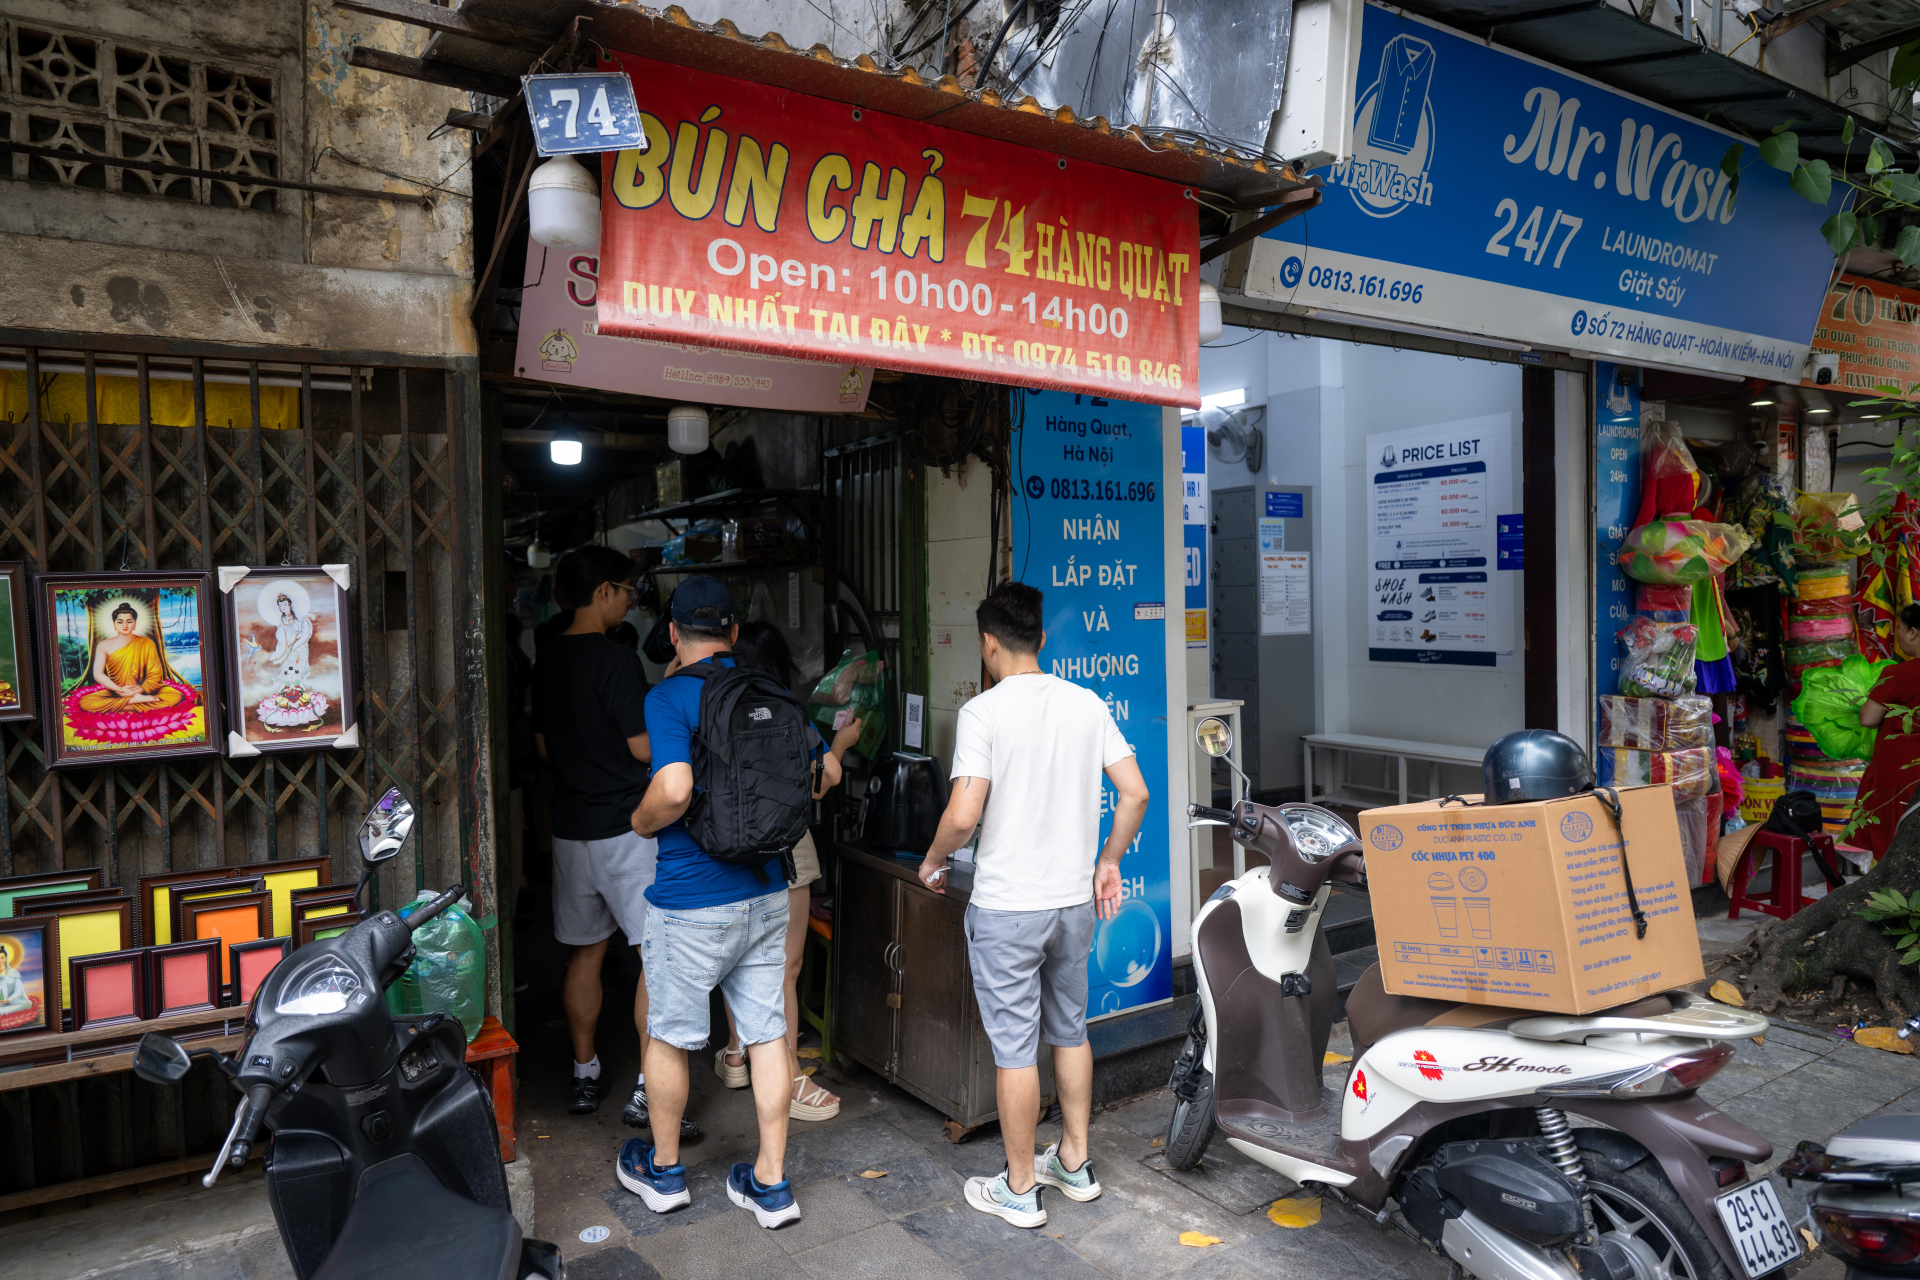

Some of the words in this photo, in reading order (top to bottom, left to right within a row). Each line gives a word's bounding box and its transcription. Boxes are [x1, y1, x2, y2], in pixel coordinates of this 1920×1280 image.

[550, 87, 619, 137] 74
[1614, 118, 1737, 225] Wash
[611, 104, 791, 234] BÚN
[806, 147, 946, 263] CHẢ
[960, 188, 1034, 277] 74
[1035, 214, 1111, 292] HÀNG
[1118, 242, 1190, 314] QUẠT
[1486, 197, 1583, 270] 24/7
[1601, 225, 1719, 277] LAUNDROMAT
[706, 236, 851, 297] Open:
[1307, 264, 1424, 305] 0813.161.696
[1618, 267, 1653, 300] Giặt
[1656, 273, 1686, 308] Sấy
[1830, 280, 1876, 326] 70
[623, 279, 697, 322] DUY
[707, 291, 800, 337] NHẤT
[809, 308, 861, 348] TẠI
[868, 314, 930, 354] ĐÂY
[961, 332, 1007, 365] ĐT:
[1013, 338, 1078, 375] 0974
[1086, 350, 1133, 382] 519
[1139, 359, 1183, 391] 846
[1588, 311, 1611, 337] SỐ
[1609, 321, 1625, 340] 72
[1626, 321, 1662, 346] HÀNG
[1776, 350, 1796, 373] NỘI
[1830, 330, 1857, 347] QUẠT
[1840, 351, 1865, 366] PHỤC
[664, 367, 703, 383] Hotline:
[755, 378, 771, 390] 993
[1046, 415, 1086, 438] Hàng
[1091, 418, 1132, 441] Quạt,
[1598, 423, 1640, 440] LAUNDROMAT
[1063, 444, 1085, 462] Hà
[1089, 447, 1114, 468] Nội
[1402, 444, 1445, 464] PRICE
[1449, 439, 1481, 458] LIST
[1610, 447, 1628, 461] OPEN
[1610, 470, 1628, 483] 24Hrs
[1050, 477, 1156, 503] 0813.161.696
[1063, 513, 1120, 545] NHẬN
[1052, 555, 1092, 587] LẮP
[1098, 558, 1138, 591] ĐẶT
[1377, 561, 1392, 570] FREE
[1375, 578, 1407, 592] SHOE
[1612, 574, 1626, 592] MỞ
[1380, 591, 1413, 606] WASH
[1609, 600, 1628, 618] CỬA
[1083, 605, 1110, 632] VÀ
[1052, 652, 1140, 682] NHƯỢNG
[1417, 823, 1438, 832] CÔNG
[1450, 823, 1472, 831] TNHH
[1473, 821, 1497, 831] NHỰA
[1498, 819, 1516, 829] ĐỨC
[1517, 819, 1537, 828] ANH
[1564, 822, 1590, 831] PLASTIC
[1580, 830, 1586, 838] A
[1434, 836, 1448, 844] DUC
[1450, 835, 1465, 843] ANH
[1465, 834, 1492, 843] PLASTIC
[1510, 833, 1523, 842] LTD
[1411, 849, 1430, 862] CỐC
[1431, 851, 1458, 863] NHỰA
[1459, 851, 1475, 861] PET
[1477, 851, 1496, 861] 400
[1564, 850, 1574, 858] Tên
[1574, 848, 1587, 857] hàng
[1597, 843, 1607, 852] Cốc
[1608, 842, 1620, 850] nhựa
[1620, 840, 1630, 848] PET
[1599, 856, 1609, 864] PET
[1598, 869, 1610, 878] Nhựa
[1611, 866, 1621, 874] PET
[1571, 886, 1586, 896] Thông
[1614, 891, 1621, 899] 01
[1401, 953, 1411, 961] QC
[1620, 954, 1632, 963] Nam
[1613, 980, 1628, 990] QCVN
[1463, 1056, 1525, 1073] SH
[1515, 1063, 1573, 1075] mode
[1726, 1185, 1776, 1233] 29-C1
[1740, 1220, 1797, 1272] 444.93
